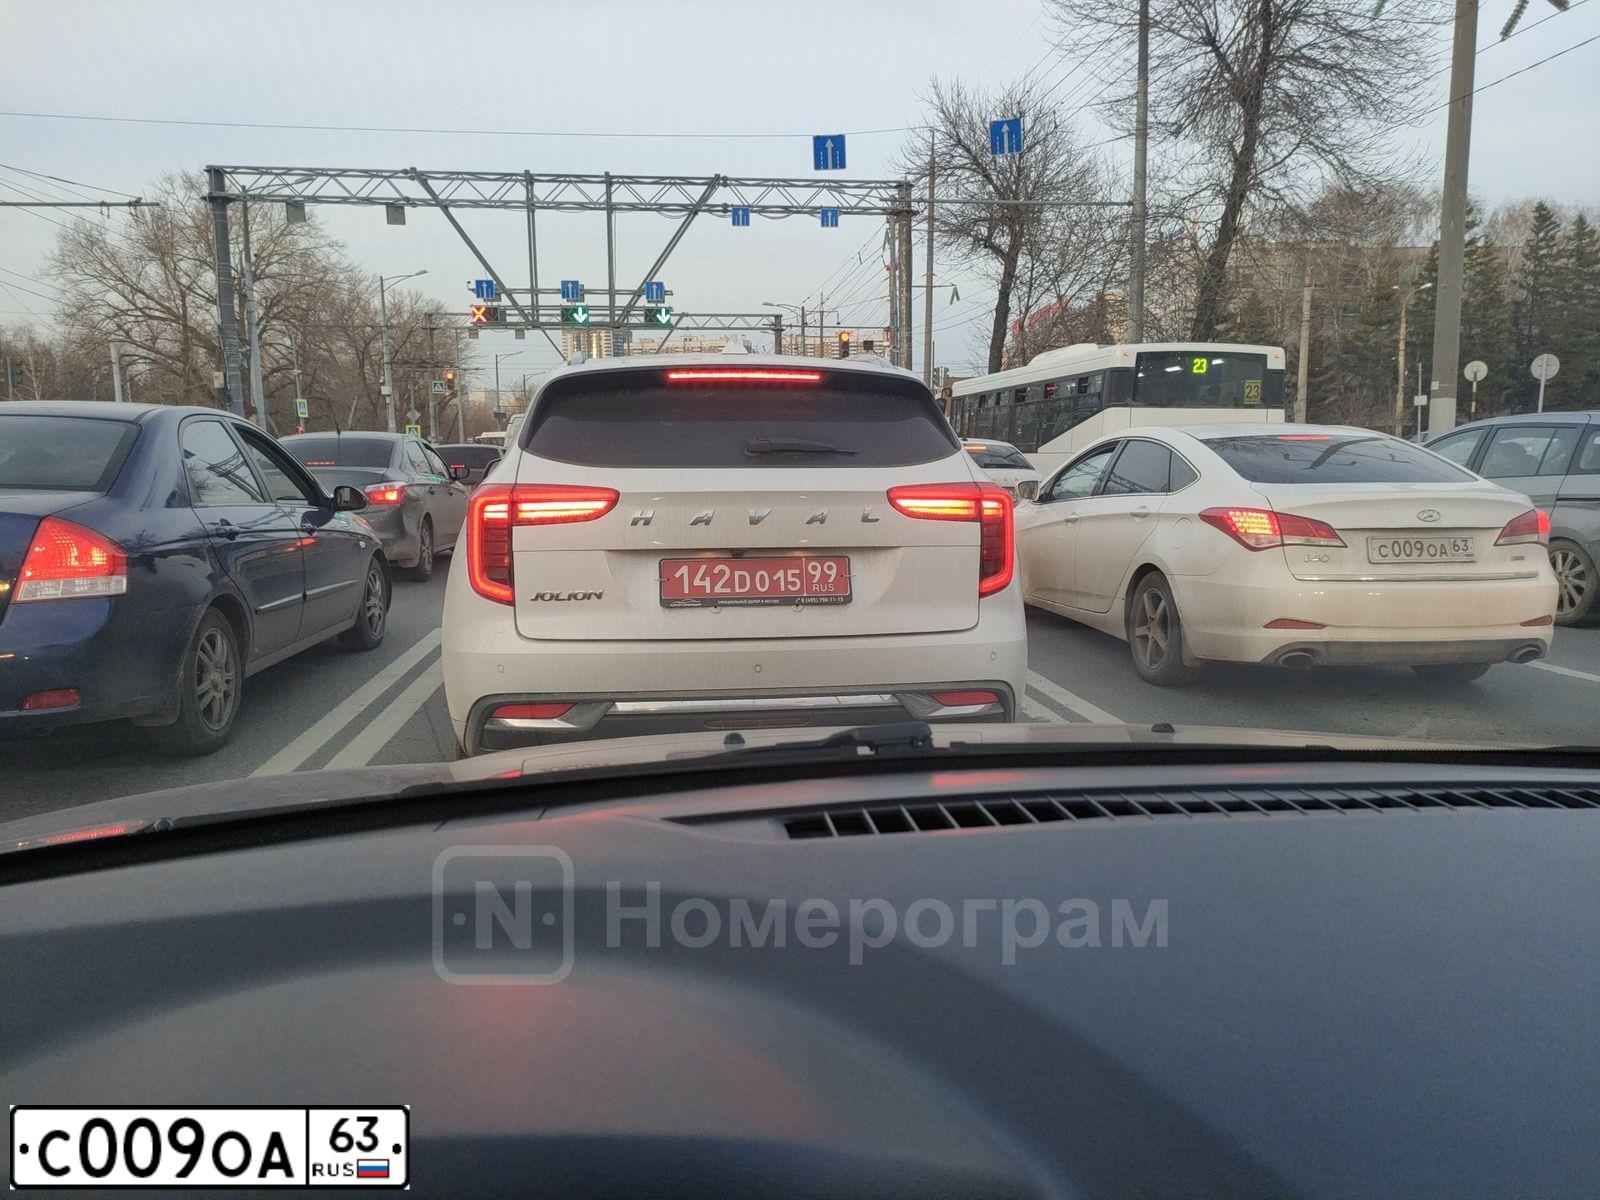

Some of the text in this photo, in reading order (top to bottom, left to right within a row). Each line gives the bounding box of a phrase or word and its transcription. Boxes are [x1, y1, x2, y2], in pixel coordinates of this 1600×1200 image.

[1193, 358, 1207, 374] 23
[1245, 384, 1260, 399] 23
[630, 507, 880, 527] HAVAL
[1452, 539, 1469, 552] 63
[807, 561, 837, 584] 99
[812, 584, 835, 592] RUS
[529, 590, 605, 602] JOLION
